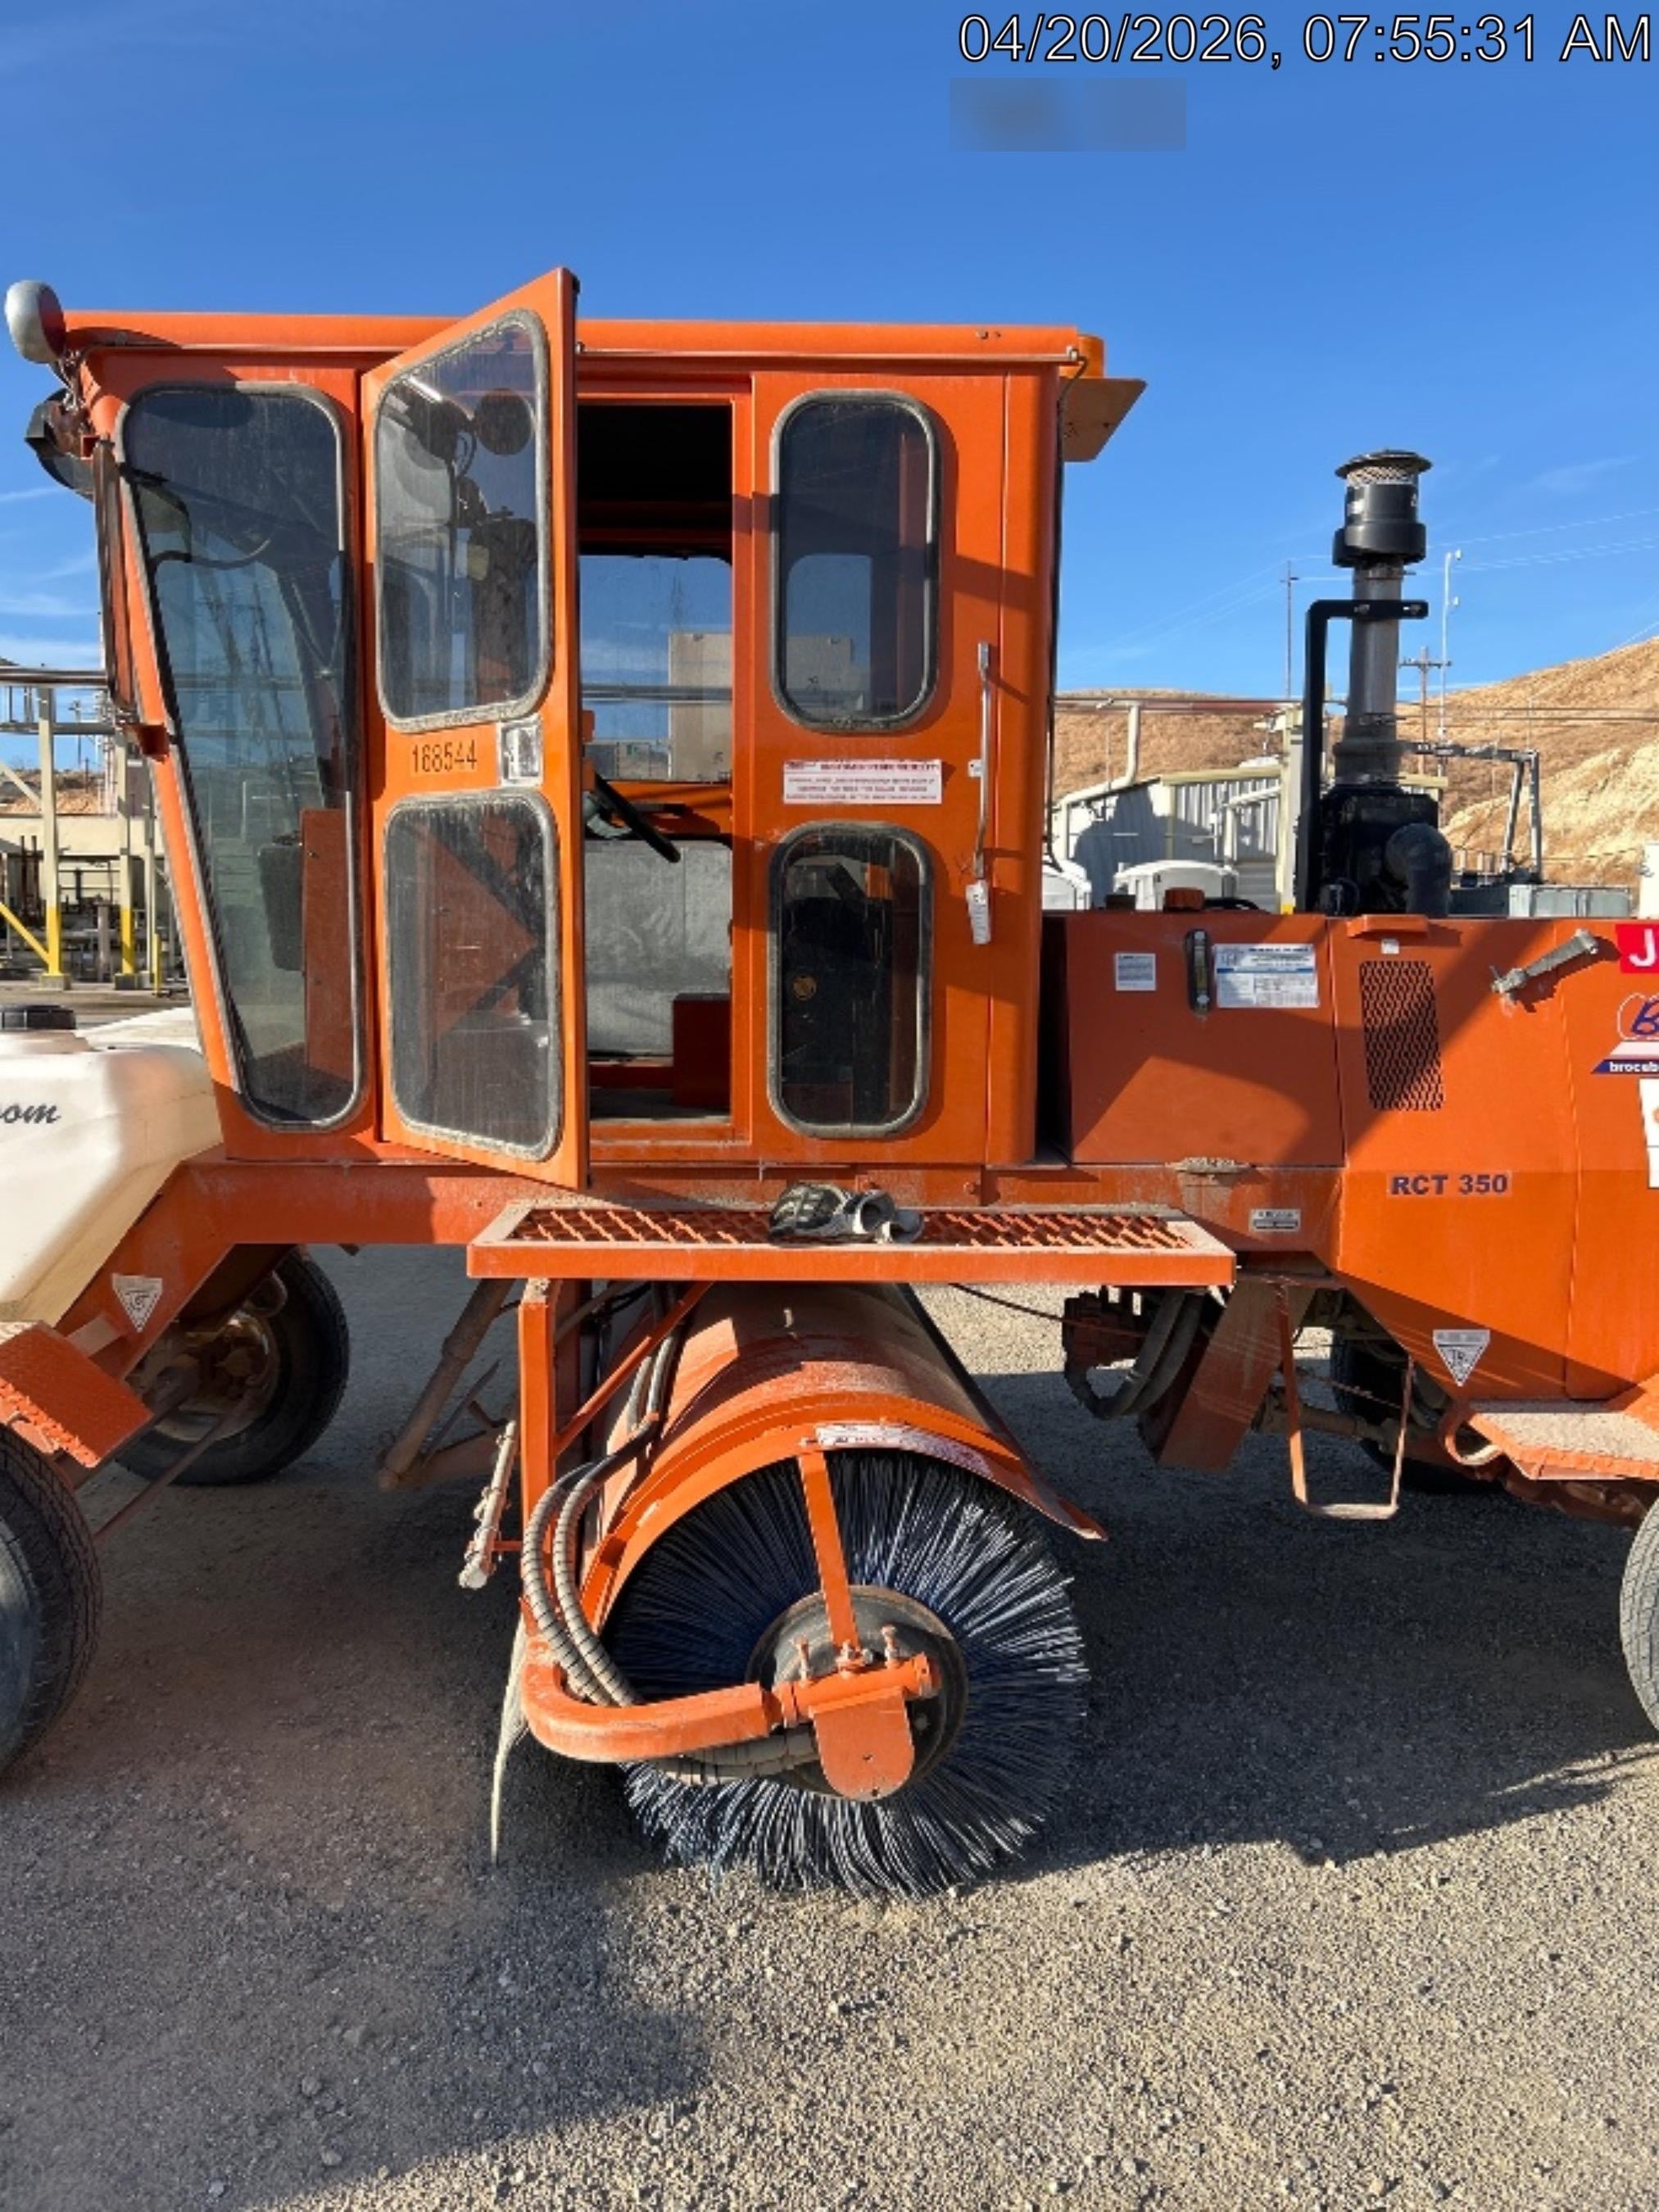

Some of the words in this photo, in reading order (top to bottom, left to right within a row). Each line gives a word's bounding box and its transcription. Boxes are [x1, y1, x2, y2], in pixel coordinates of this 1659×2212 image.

[412, 739, 478, 773] 168544
[1391, 1175, 1448, 1195] RCT
[1458, 1174, 1508, 1194] 350
